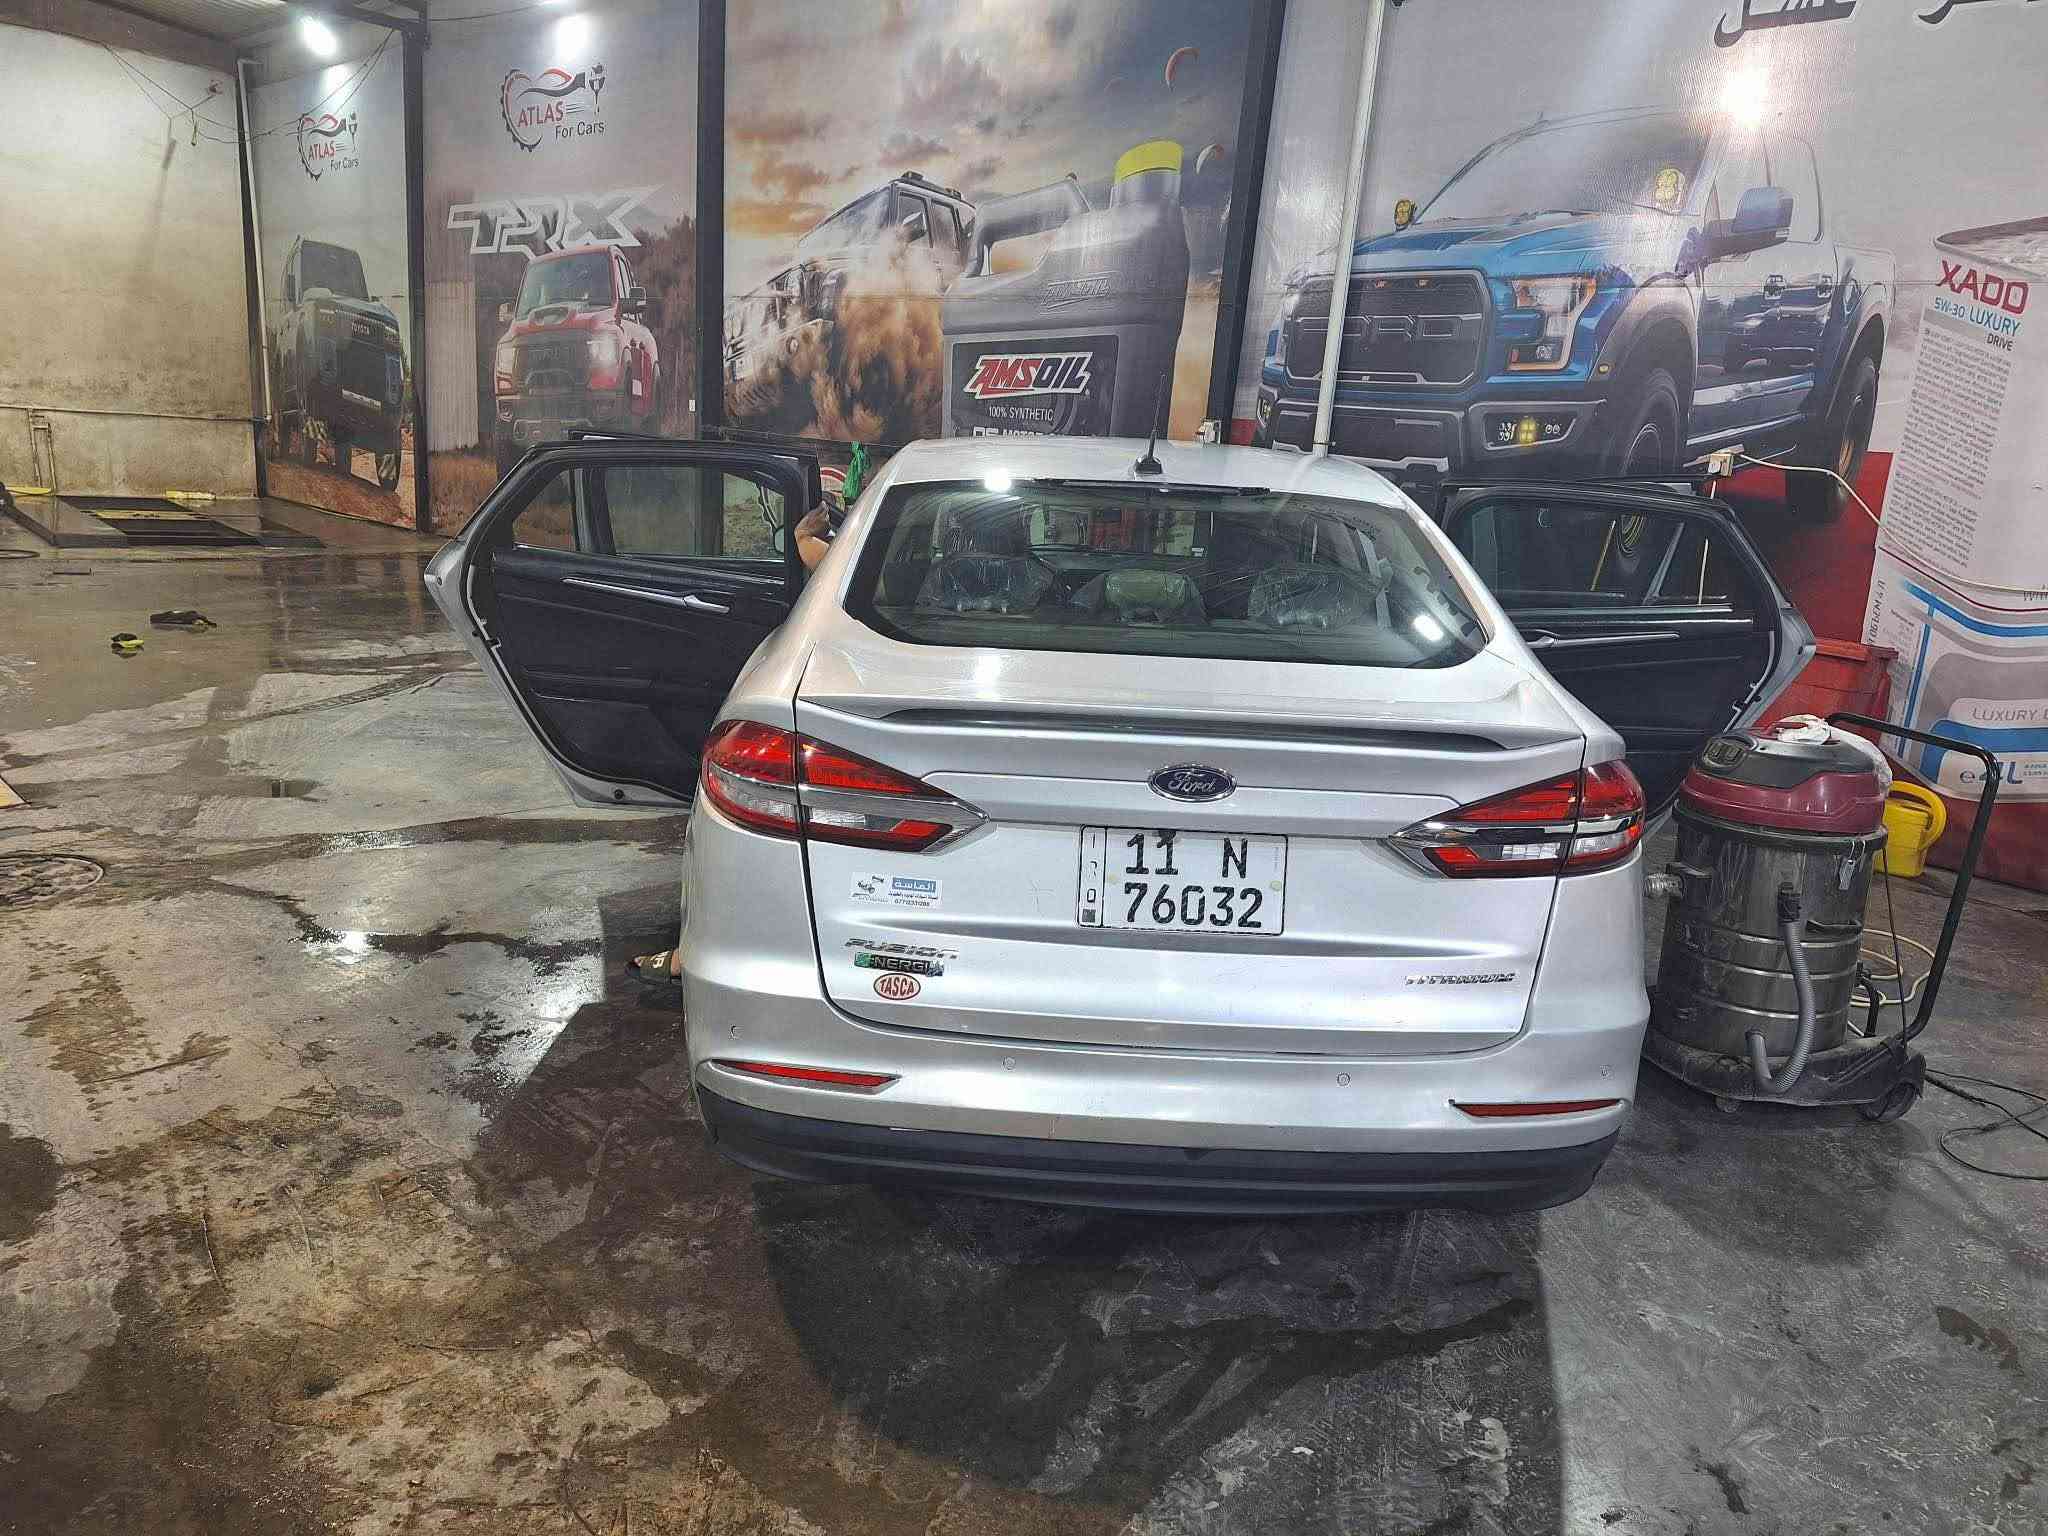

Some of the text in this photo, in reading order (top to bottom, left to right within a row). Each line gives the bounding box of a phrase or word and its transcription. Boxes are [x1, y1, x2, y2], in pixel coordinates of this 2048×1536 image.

[517, 101, 565, 128] ATLAS
[555, 121, 605, 140] For Cars
[308, 141, 335, 161] ATLAS
[330, 158, 359, 171] For Cars
[447, 184, 665, 260] TRX
[1936, 260, 2029, 315] XADO
[1934, 297, 2021, 337] 5W-30 LUXURY
[1986, 333, 2014, 352] DRIVE
[964, 353, 1092, 399] AMSOIL
[988, 406, 1054, 421] 100% SYNTHETIC
[1972, 707, 2038, 721] LUXURY
[1167, 772, 1216, 794] Ford
[1125, 833, 1248, 879] 11 N
[1123, 881, 1264, 929] 76032
[879, 976, 916, 997] TASCA
